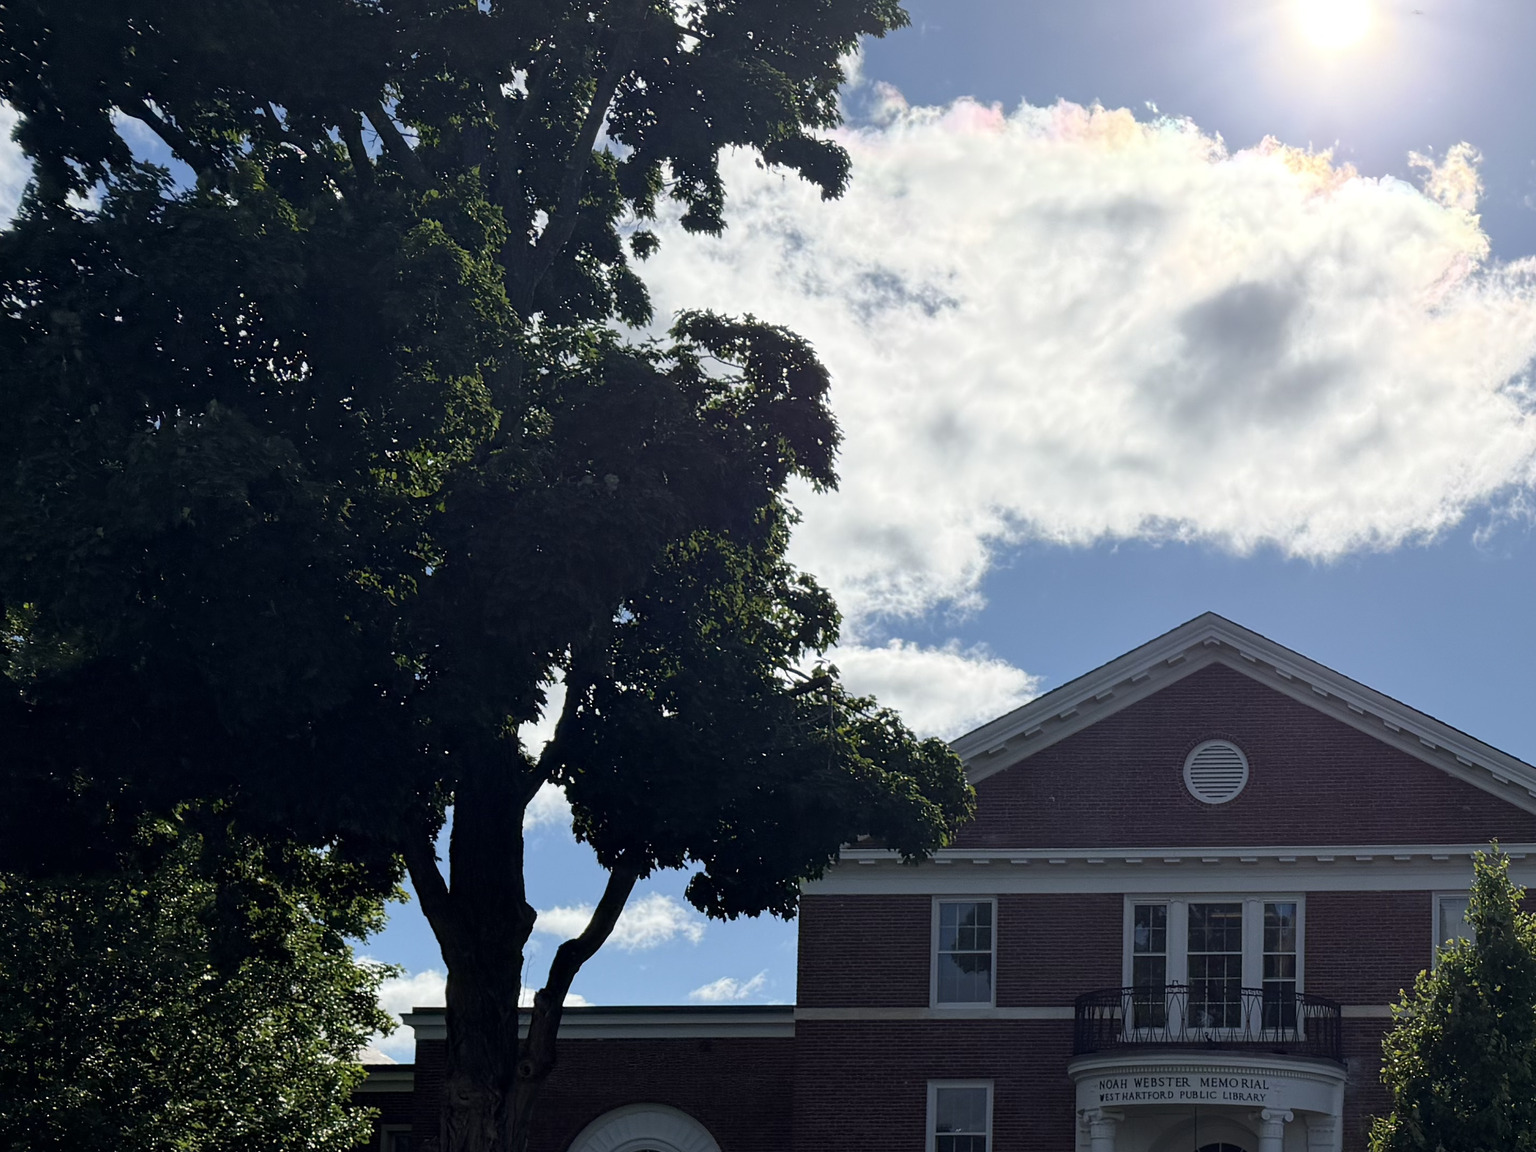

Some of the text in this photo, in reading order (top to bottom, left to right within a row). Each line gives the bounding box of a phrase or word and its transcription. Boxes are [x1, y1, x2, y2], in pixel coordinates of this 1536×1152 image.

[1100, 1077, 1269, 1090] NOAH WEBSTER MEMORIAL
[1100, 1090, 1266, 1102] WEST HARTFORD PUBLIC LIBRARY
